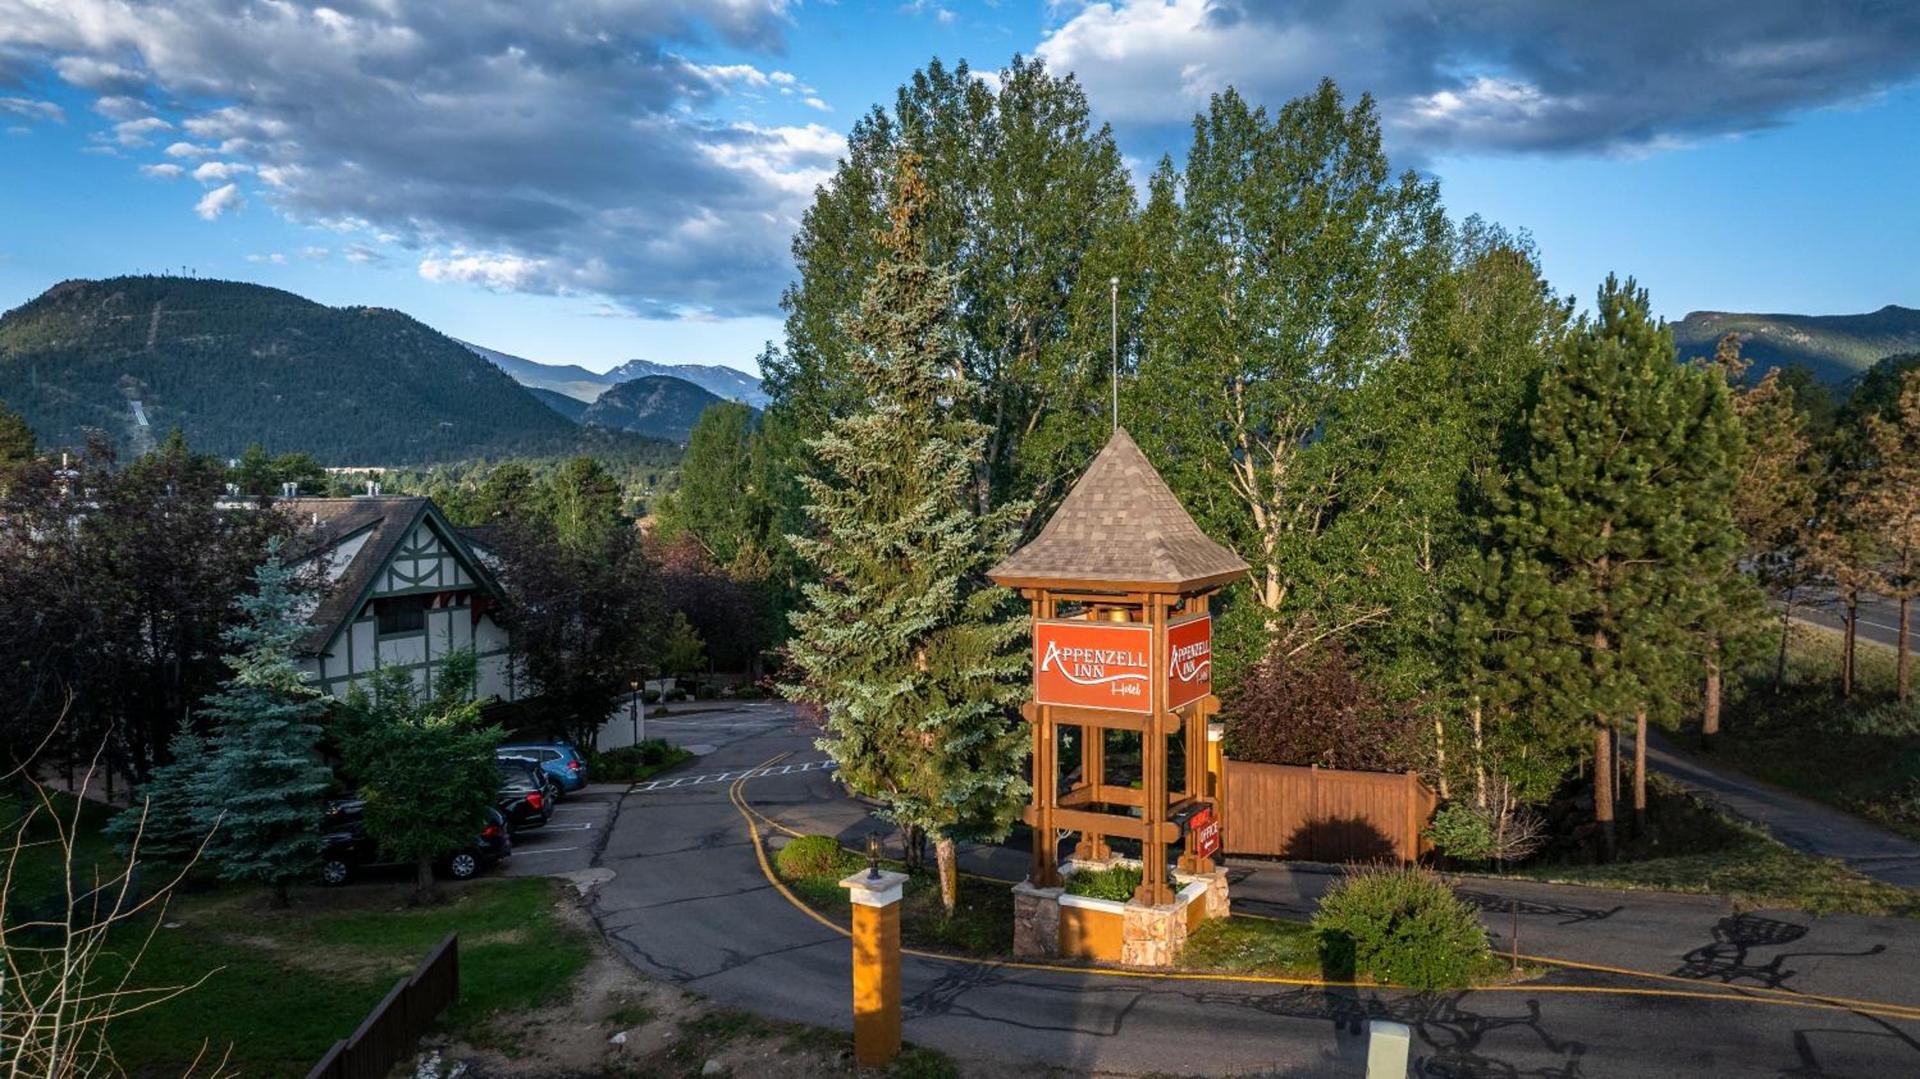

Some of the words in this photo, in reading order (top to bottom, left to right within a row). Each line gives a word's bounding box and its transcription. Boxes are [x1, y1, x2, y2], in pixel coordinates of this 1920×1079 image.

[1041, 641, 1148, 672] APPENZELL
[1074, 663, 1105, 678] INN
[1111, 681, 1142, 696] Hotel
